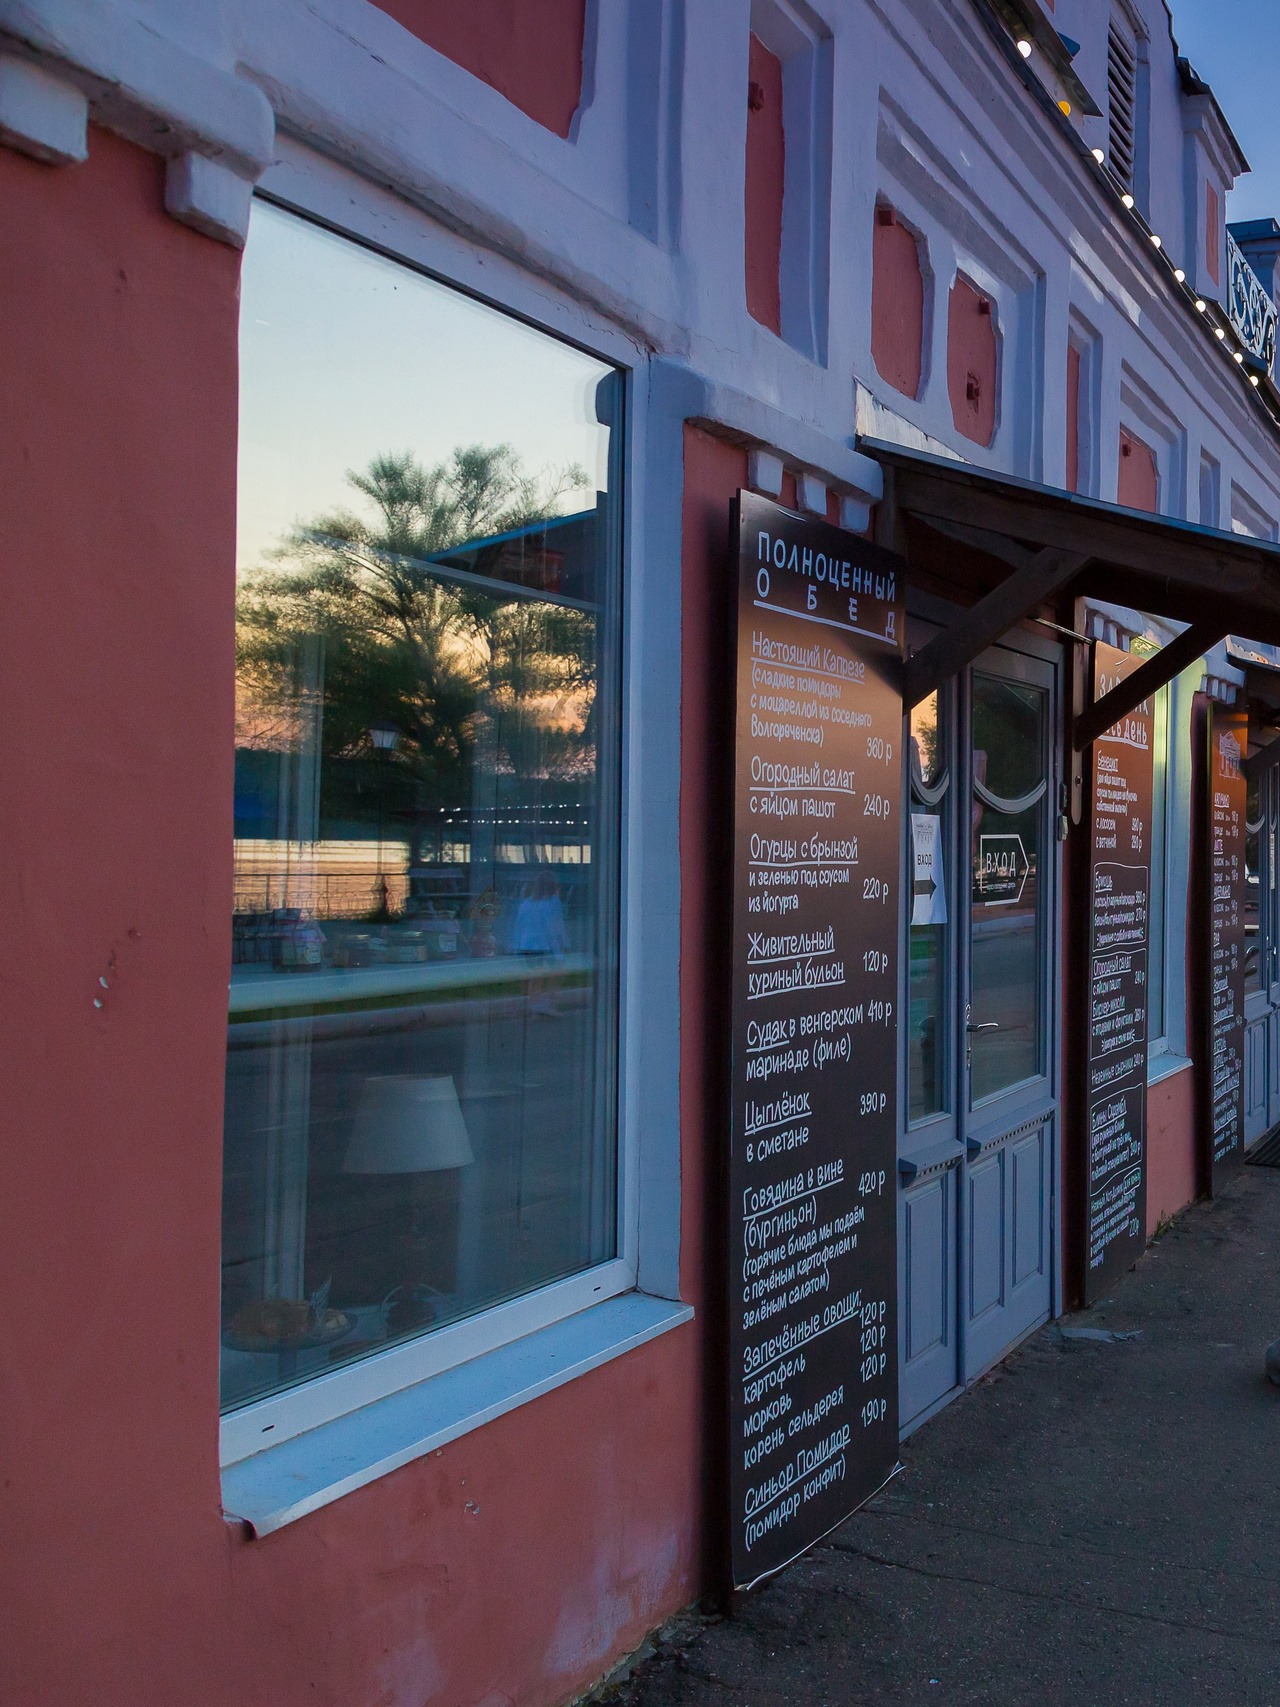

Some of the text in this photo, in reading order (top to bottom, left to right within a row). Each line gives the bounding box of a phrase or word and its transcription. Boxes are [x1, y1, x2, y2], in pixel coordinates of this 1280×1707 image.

[758, 531, 895, 602] ПОЛНОЦЕННЫЙ
[752, 630, 865, 678] Настоящий Капрезе
[797, 677, 841, 701] помидоры
[751, 694, 757, 709] с
[759, 696, 817, 719] моцареллой
[819, 705, 829, 720] из
[866, 737, 884, 759] 360
[1124, 718, 1147, 744] день
[751, 755, 855, 789] Огородный салат
[750, 796, 757, 813] с
[760, 791, 798, 821] яйцом
[802, 798, 836, 818] пашот
[863, 793, 882, 817] 240
[750, 831, 858, 866] Огурцы с брынзой
[917, 854, 932, 868] ВХОД
[986, 851, 1016, 877] ВХОД
[749, 868, 850, 888] и зеленью под соусом
[863, 877, 880, 900] 220
[748, 891, 799, 915] из йогурта
[747, 925, 834, 959] Живительный
[748, 957, 844, 999] куриный бульон
[863, 950, 879, 972] 120
[747, 1020, 787, 1052] Судак
[789, 1018, 796, 1037] в
[800, 1004, 863, 1036] венгерском
[867, 999, 883, 1022] 410
[746, 1032, 851, 1081] маринаде (филе)
[745, 1091, 811, 1135] Цыплёнок
[860, 1092, 877, 1115] 390
[746, 1126, 809, 1163] в сметане
[743, 1158, 844, 1215] Говядина в вине
[858, 1173, 876, 1197] 420
[743, 1195, 817, 1257] (бургиньон)
[743, 1205, 865, 1282] (горячие блюда мы подаём
[743, 1286, 749, 1302] с
[796, 1238, 851, 1276] картофелем
[851, 1233, 858, 1249] и
[742, 1267, 830, 1330] зелёным салатом)
[859, 1303, 877, 1329] 120
[743, 1314, 820, 1373] Запечённые
[860, 1328, 878, 1354] 120
[744, 1353, 806, 1405] картофель
[860, 1357, 878, 1383] 120
[743, 1393, 792, 1437] морковь
[744, 1384, 844, 1470] корень сельдерея
[861, 1399, 879, 1428] 190
[744, 1424, 850, 1515] Синьор Помидор
[745, 1453, 846, 1552] (помидор конфит)
